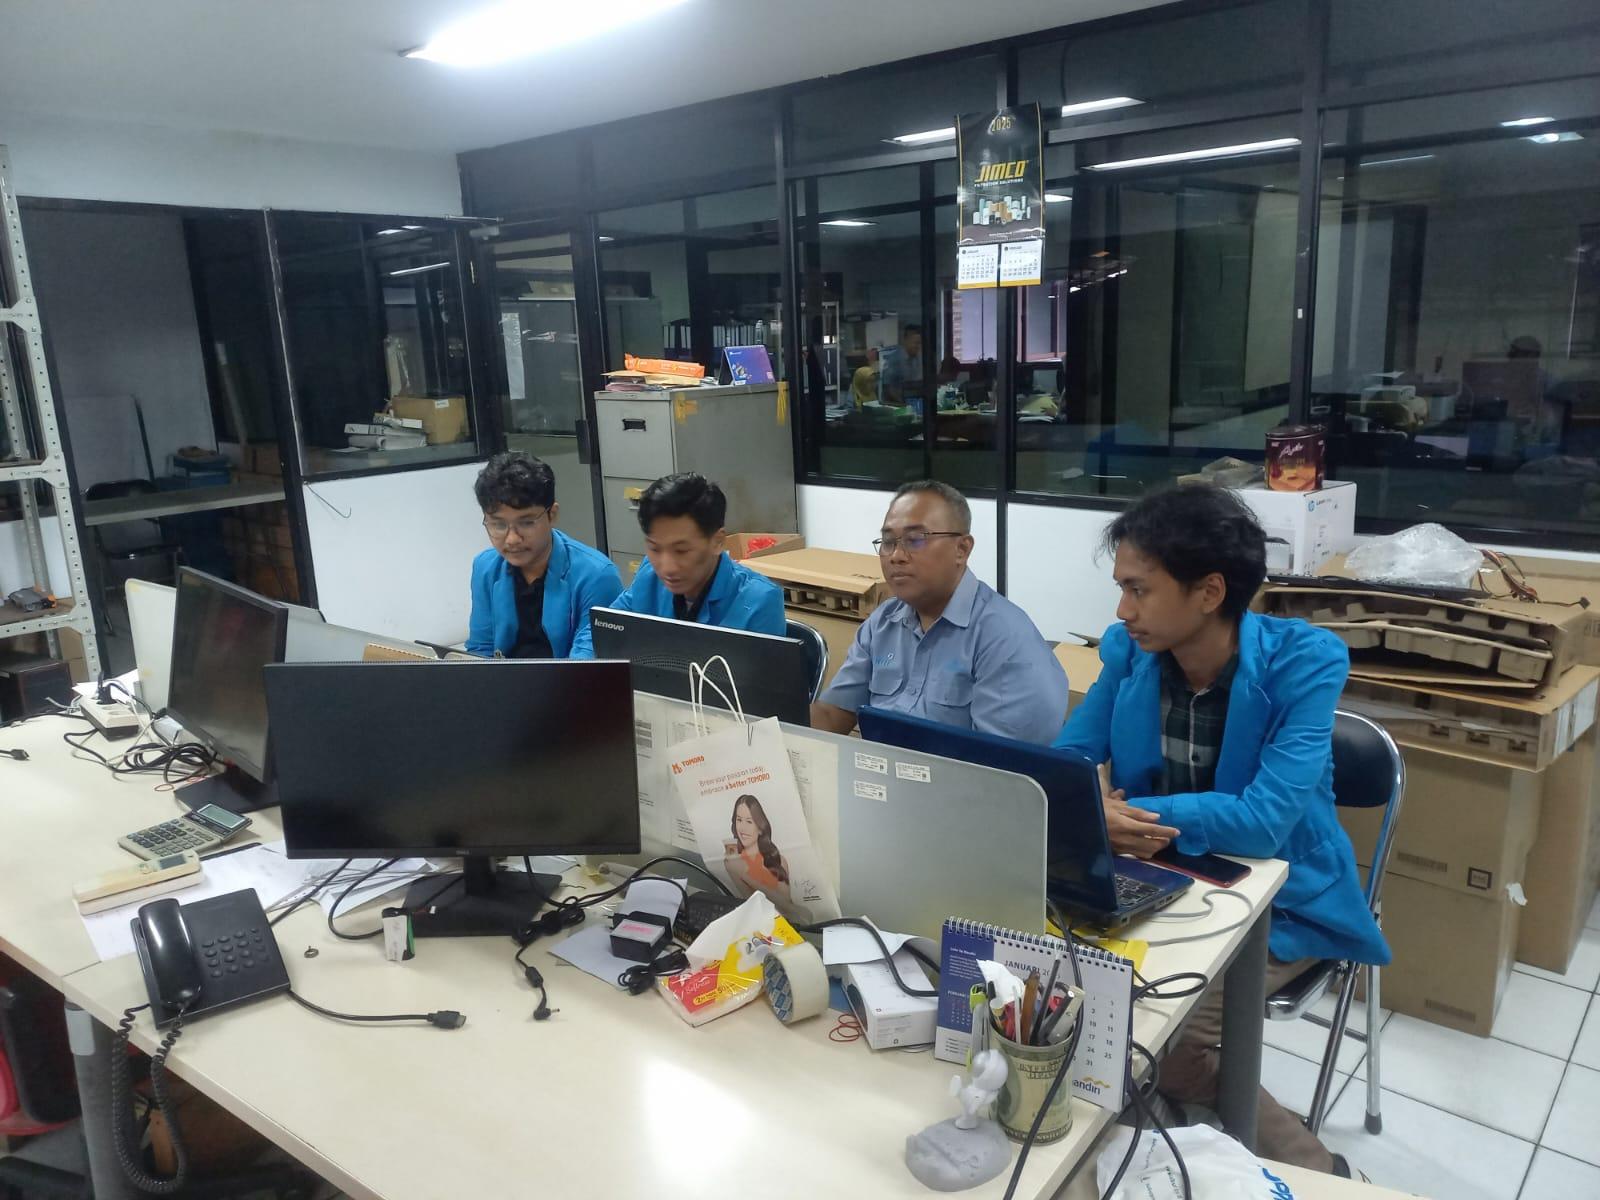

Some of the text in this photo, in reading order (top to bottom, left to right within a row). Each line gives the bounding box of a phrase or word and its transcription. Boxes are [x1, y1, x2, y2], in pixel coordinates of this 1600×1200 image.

[974, 160, 1026, 182] JIMCO
[594, 618, 625, 632] lenovo
[682, 755, 705, 767] TOMORO
[728, 779, 747, 790] better
[747, 772, 770, 784] TOMORO
[1004, 960, 1040, 973] JANUARI
[1072, 1079, 1101, 1095] andiri
